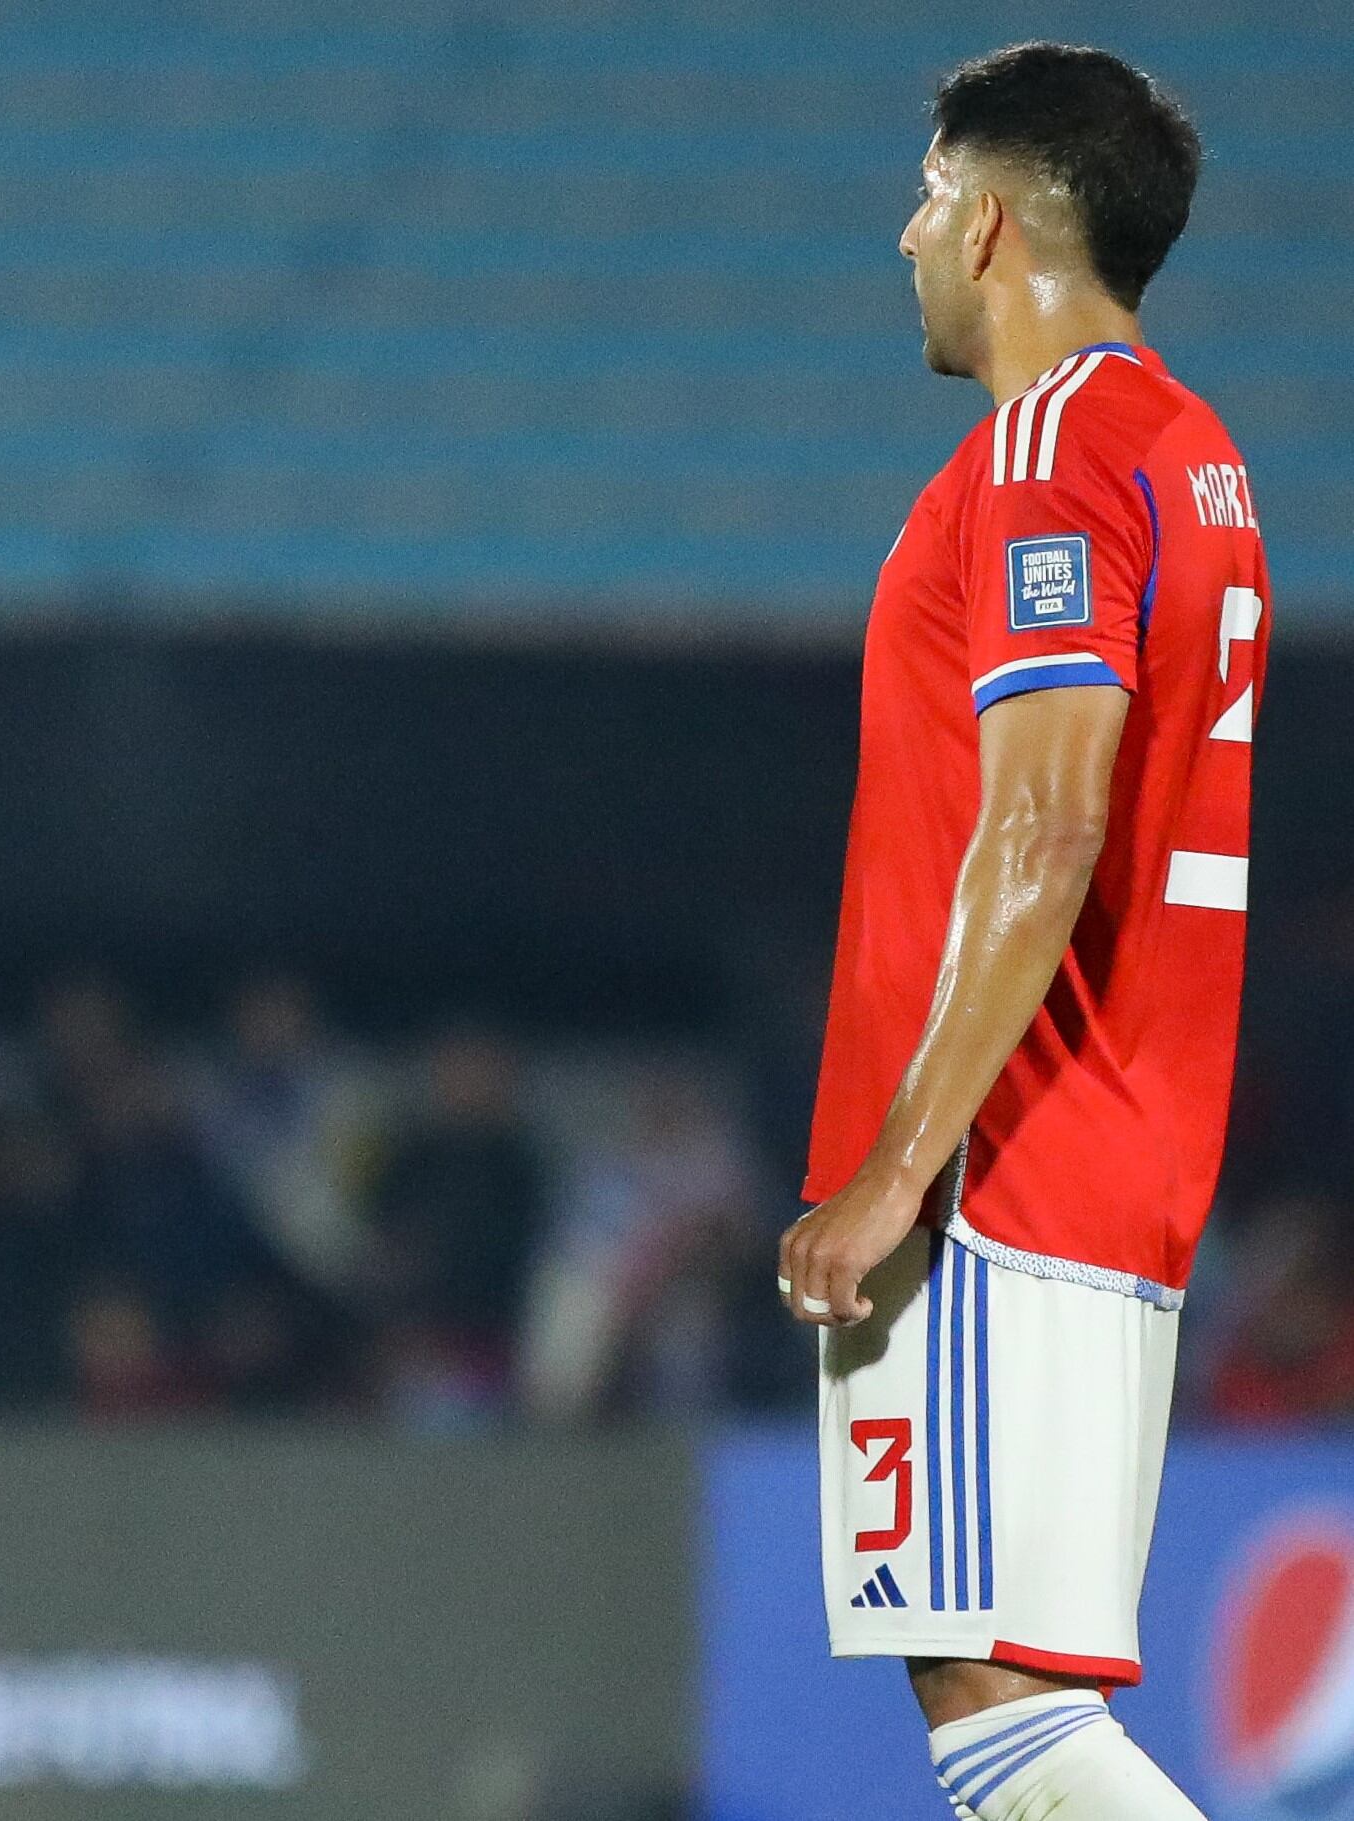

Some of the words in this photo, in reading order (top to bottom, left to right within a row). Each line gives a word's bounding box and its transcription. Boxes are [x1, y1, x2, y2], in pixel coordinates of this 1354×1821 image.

[1186, 463, 1260, 537] MARI
[1022, 550, 1072, 567] FOOTBALL
[1023, 563, 1072, 584] UNITES
[1021, 584, 1040, 600] the
[1041, 580, 1076, 597] World
[1037, 600, 1061, 613] FIFA
[850, 1417, 913, 1553] 3
